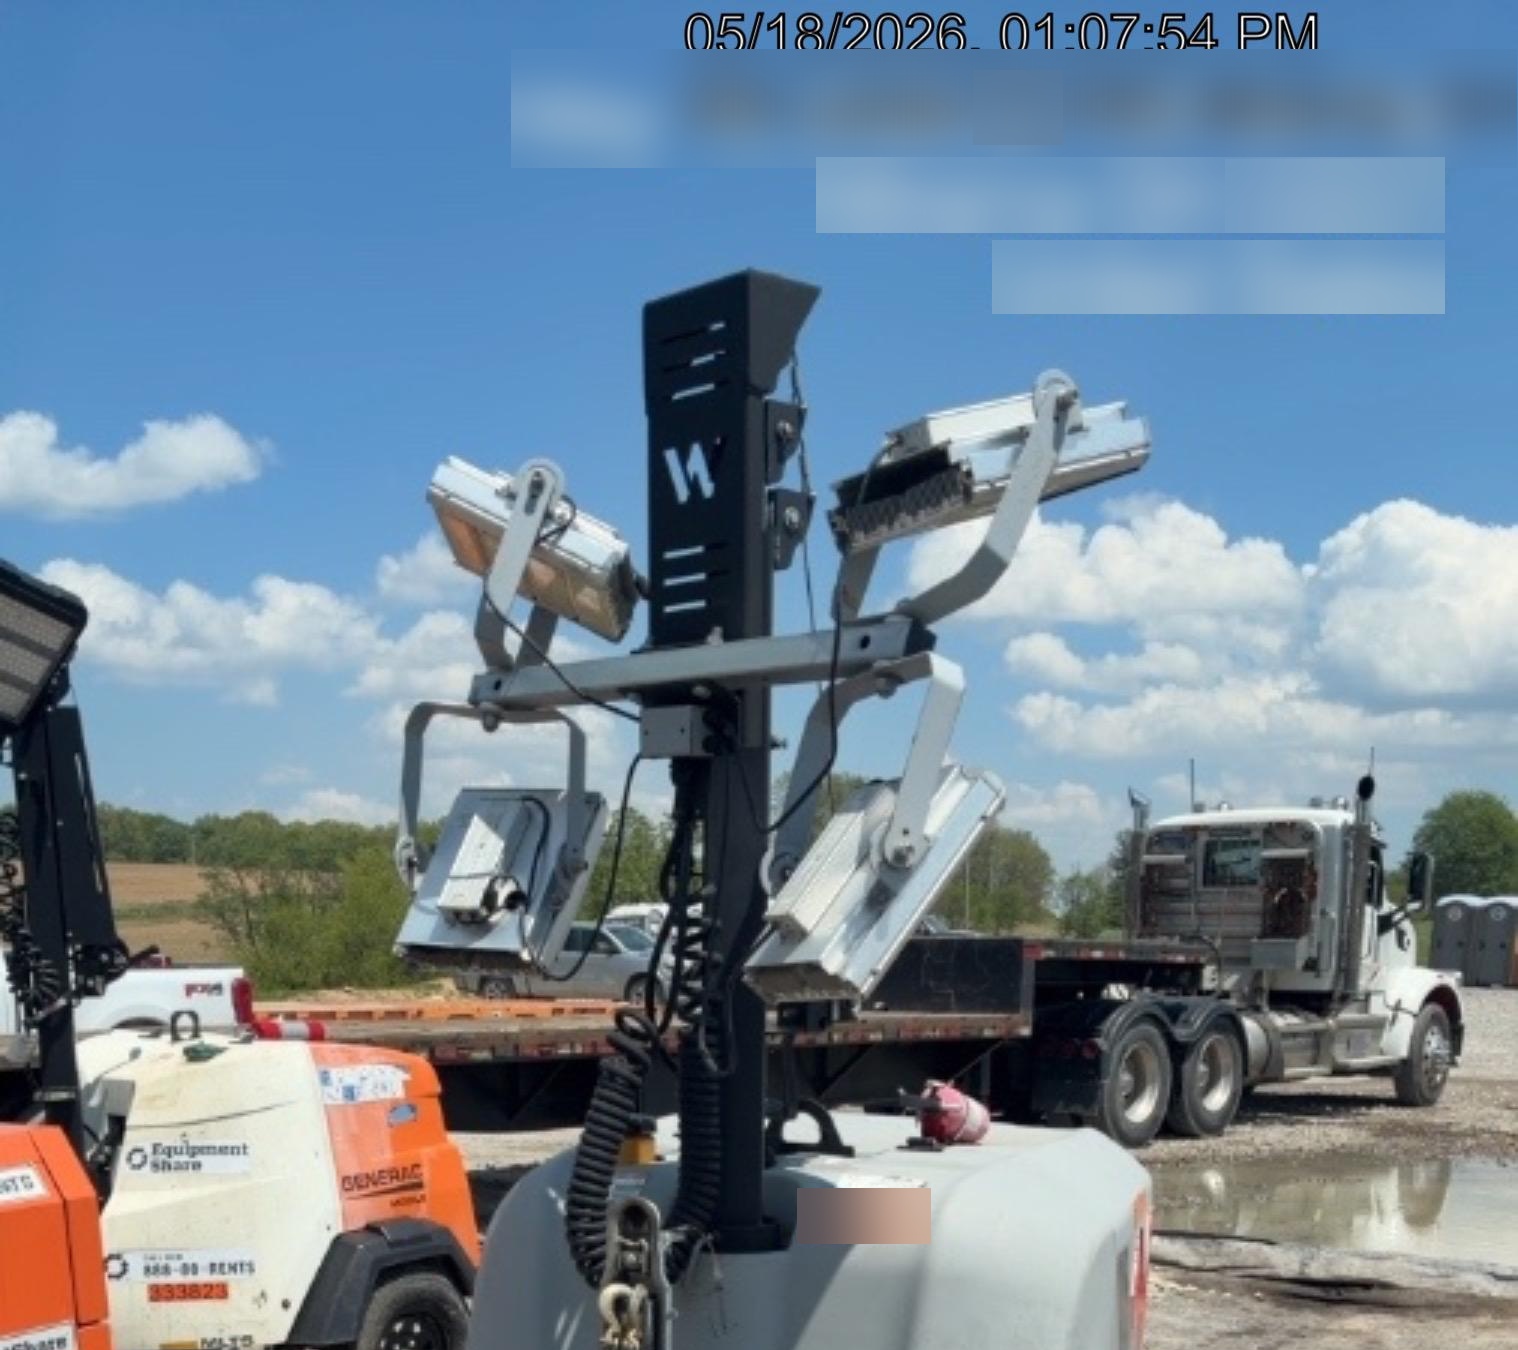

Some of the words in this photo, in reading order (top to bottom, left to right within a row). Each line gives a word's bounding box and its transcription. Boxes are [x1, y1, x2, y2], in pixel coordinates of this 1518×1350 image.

[151, 1141, 249, 1159] Equipment
[150, 1159, 202, 1173] Share
[341, 1163, 423, 1192] GENERAC
